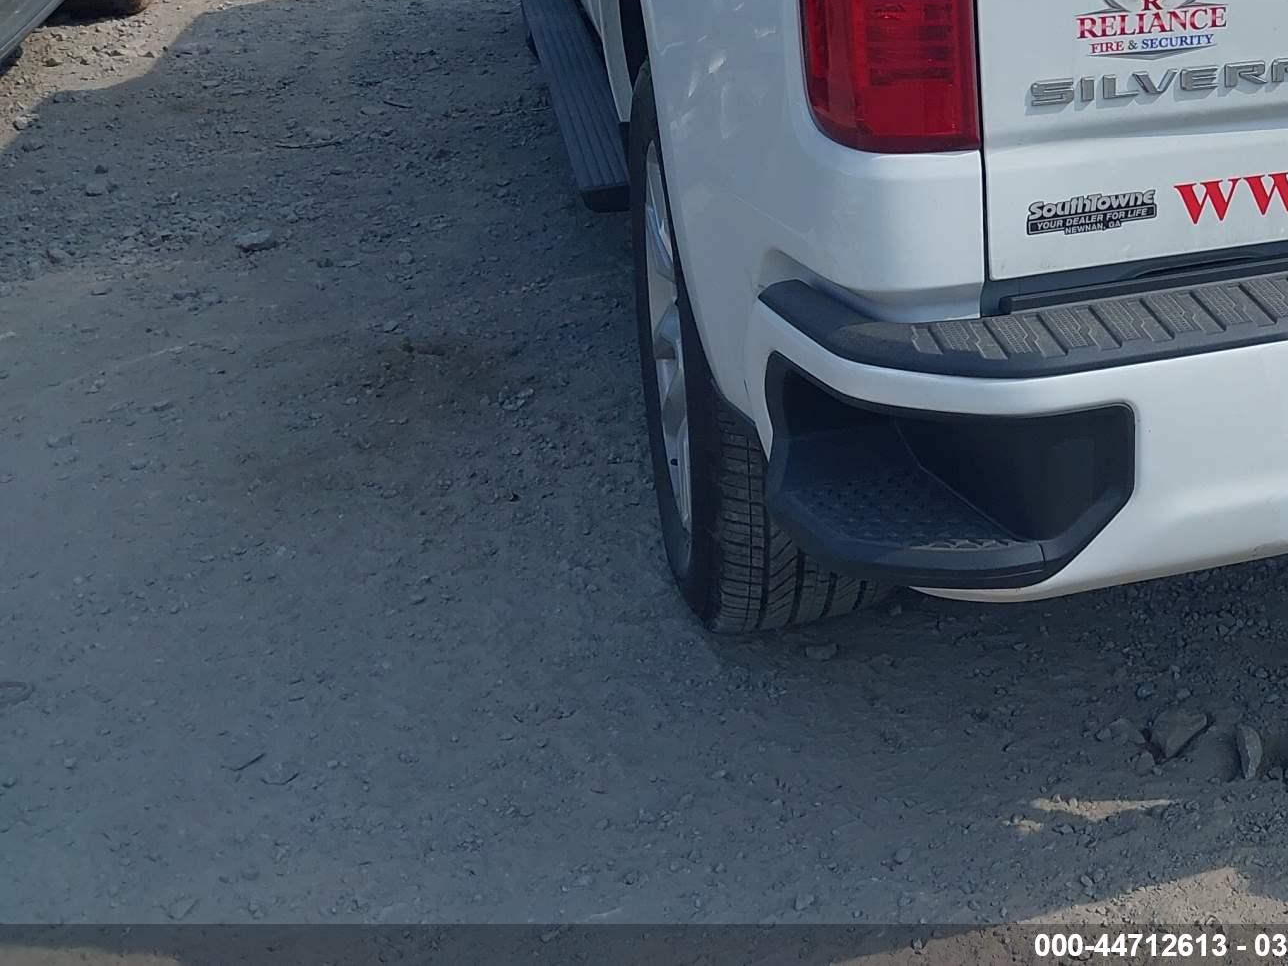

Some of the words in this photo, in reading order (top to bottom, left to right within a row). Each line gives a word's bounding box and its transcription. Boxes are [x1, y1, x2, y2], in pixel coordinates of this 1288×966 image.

[1076, 6, 1228, 39] RELIANCE
[1089, 39, 1124, 54] FIRE
[1128, 39, 1138, 51] &
[1141, 34, 1214, 50] SECURITY
[1037, 219, 1067, 231] YOUR
[1066, 214, 1104, 227] DEALER
[1106, 210, 1126, 221] FOR
[1128, 208, 1148, 218] LIFE
[1065, 222, 1106, 235] NEWNAN,
[1108, 220, 1121, 229] GA
